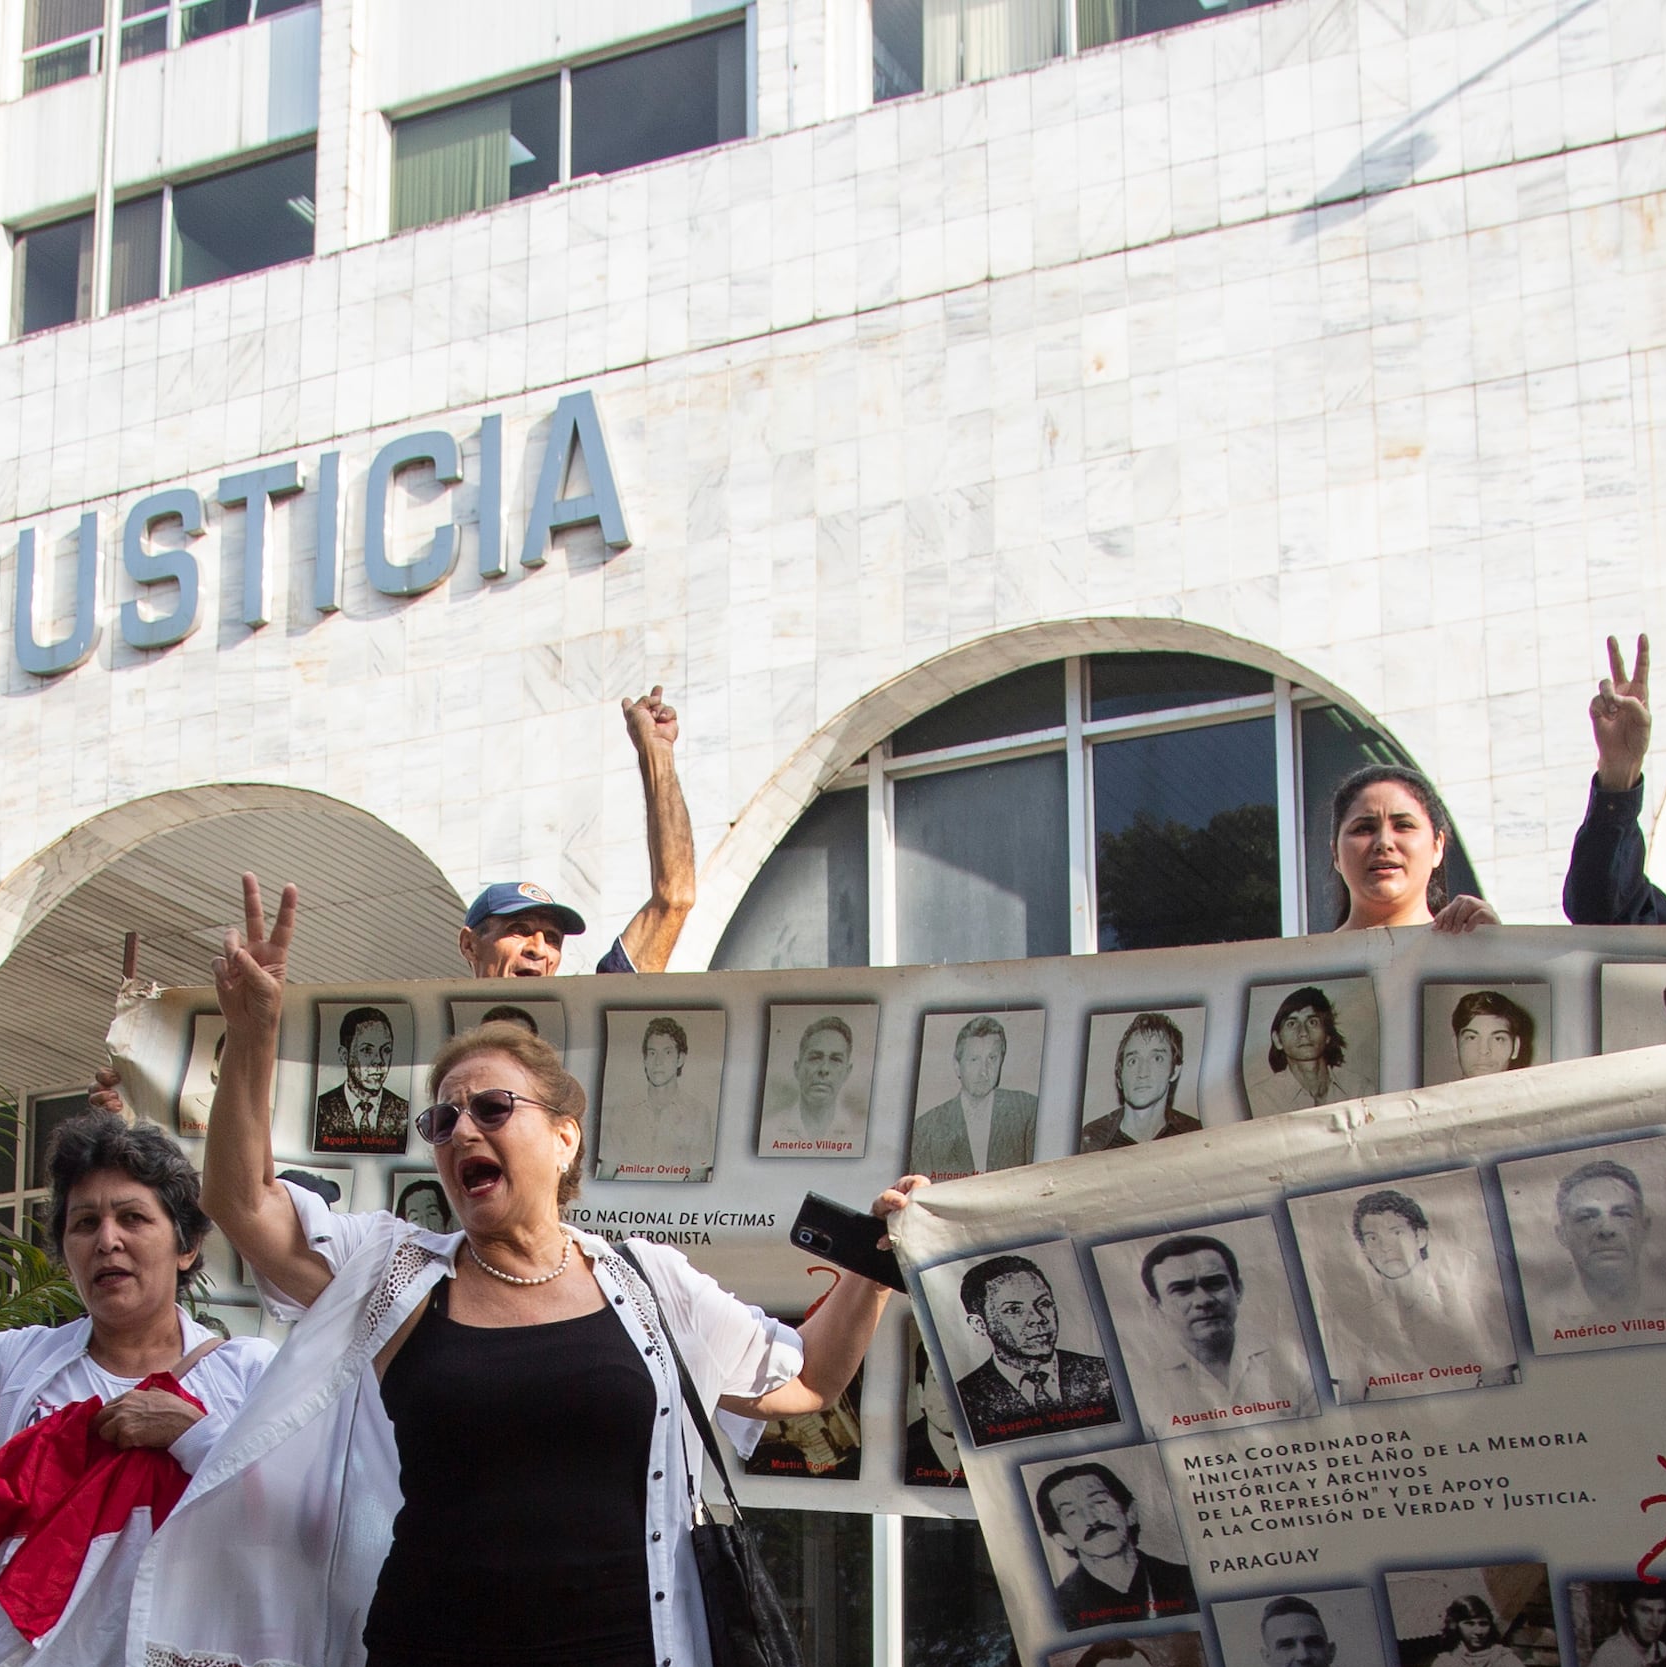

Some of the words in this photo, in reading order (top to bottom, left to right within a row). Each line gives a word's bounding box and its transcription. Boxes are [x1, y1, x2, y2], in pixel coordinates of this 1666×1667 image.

[772, 1140, 813, 1150] Americo
[815, 1140, 853, 1151] Villagra
[619, 1164, 654, 1174] Amilcar
[657, 1164, 691, 1174] Oviedo
[931, 1171, 968, 1180] Antonio
[561, 1209, 591, 1222] NTO
[596, 1209, 673, 1225] NACIONAL
[679, 1212, 699, 1225] DE
[706, 1210, 776, 1227] VÍCTIMAS
[584, 1229, 624, 1242] DURA
[629, 1230, 711, 1245] STRONISTA
[1553, 1322, 1617, 1341] Américo
[1367, 1371, 1424, 1388] Amilcar
[1429, 1362, 1482, 1379] Oviedo
[1171, 1408, 1228, 1426] Agustín
[1183, 1453, 1238, 1471] MESA
[1244, 1431, 1412, 1461] COORDINADORA
[1188, 1459, 1318, 1485] "INICIATIVAS
[1326, 1454, 1363, 1469] DEL
[1371, 1447, 1414, 1464] AÑO
[1423, 1444, 1449, 1458] DE
[1457, 1441, 1481, 1454] LA
[1487, 1431, 1588, 1451] MEMORIA
[915, 1467, 949, 1478] Carlos
[1192, 1480, 1300, 1505] HISTÓRICA
[1306, 1478, 1317, 1489] Y
[1326, 1465, 1428, 1487] ARCHIVOS
[1197, 1509, 1222, 1522] DE
[1231, 1505, 1253, 1517] LA
[1260, 1486, 1379, 1513] REPRESIÓN"
[1388, 1487, 1398, 1498] Y
[1408, 1483, 1433, 1497] DE
[1441, 1476, 1510, 1494] APOYO
[1202, 1528, 1214, 1539] A
[1221, 1524, 1243, 1537] LA
[1250, 1508, 1354, 1532] COMISIÓN
[1363, 1507, 1387, 1520] DE
[1394, 1499, 1476, 1517] VERDAD
[1483, 1497, 1494, 1509] Y
[1503, 1490, 1596, 1511] JUSTICIA.
[1209, 1548, 1320, 1574] PARAGUAY
